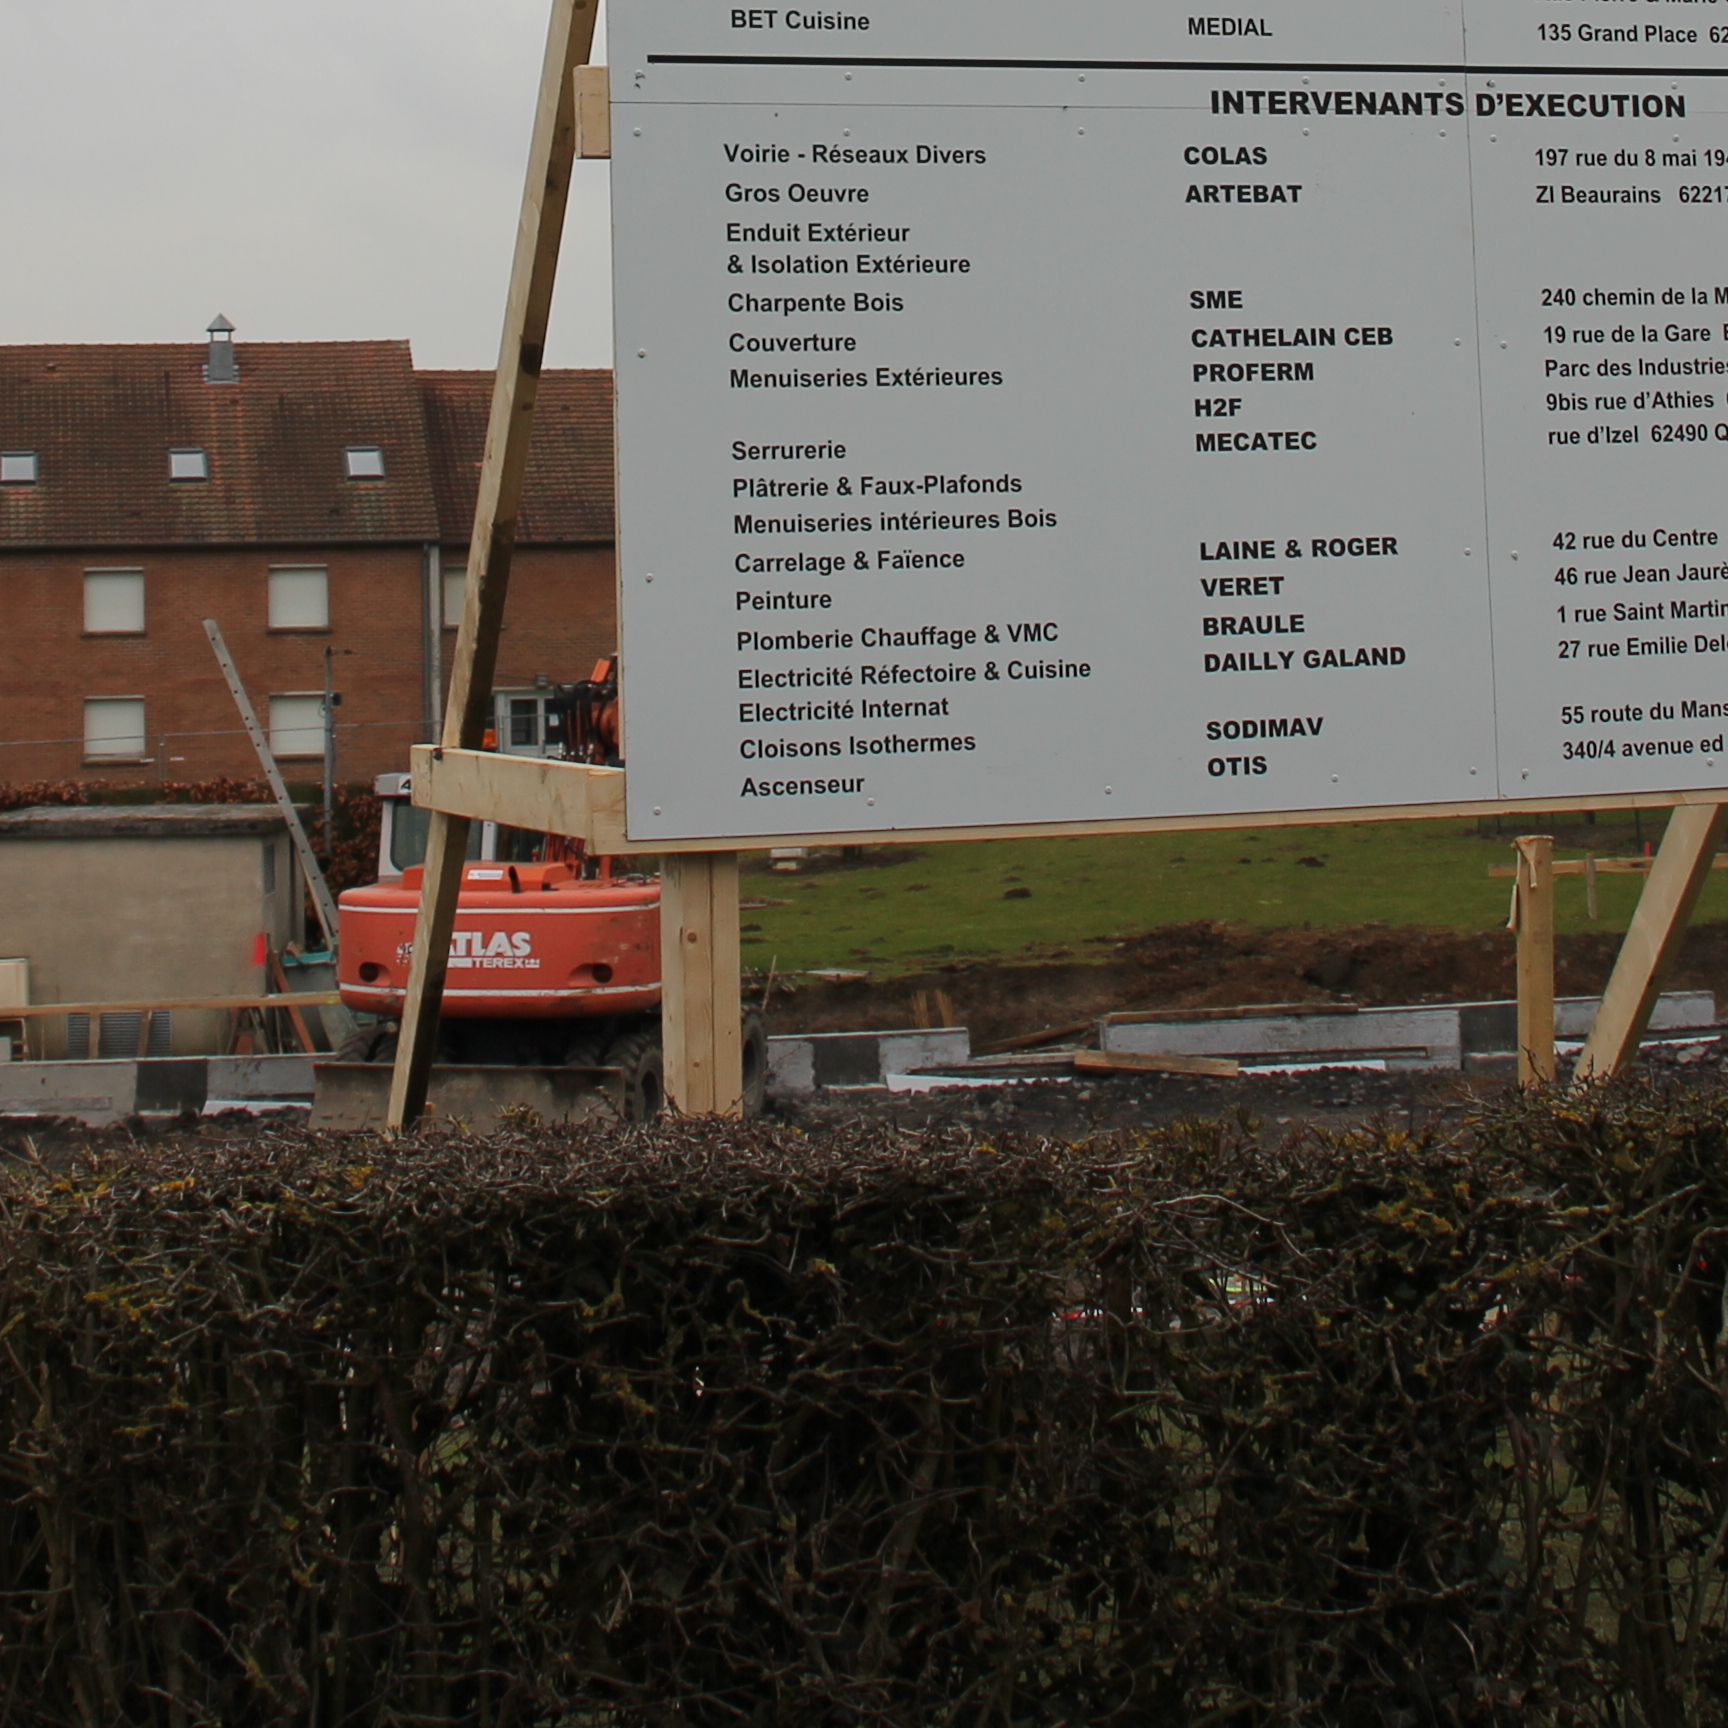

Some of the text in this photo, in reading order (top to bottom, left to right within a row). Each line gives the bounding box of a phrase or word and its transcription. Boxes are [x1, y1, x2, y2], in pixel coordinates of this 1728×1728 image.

[731, 9, 870, 31] BET Cuisine
[1188, 17, 1273, 37] MEDIAL
[1537, 23, 1572, 42] 135
[1577, 23, 1638, 43] Grand
[1644, 24, 1698, 43] Place
[1210, 90, 1686, 118] INTERVENANTS D'EXECUTION
[1183, 146, 1268, 166] COLAS
[725, 182, 869, 203] Gros Oeuvre
[1185, 184, 1303, 203] ARTEBAT
[1535, 185, 1555, 204] ZI
[1561, 185, 1662, 204] Beaurains
[726, 222, 911, 243] Enduit Extérieur
[728, 292, 904, 317] Charpente Bois
[1189, 290, 1243, 310] SME
[729, 332, 857, 353] Couverture
[1191, 327, 1394, 348] CATHELAIN CEB
[730, 366, 1003, 389] Menuiseries Extérieures
[1192, 362, 1314, 383] PROFERM
[1194, 397, 1242, 418] H2F
[731, 439, 847, 461] Serrurerie
[1195, 431, 1317, 453] MECATEC
[734, 508, 1058, 535] Menuiseries intérieures Bois
[1200, 575, 1285, 597] VERET
[736, 590, 832, 611] Peinture
[1202, 614, 1305, 637] BRAULE
[1204, 646, 1406, 673] DAILLY GALAND
[739, 697, 949, 723] Electricité Internat
[1206, 716, 1324, 741] SODIMAV
[1207, 755, 1268, 777] OTIS
[740, 777, 865, 798] Ascenseur
[449, 931, 532, 957] TLAS
[472, 957, 525, 969] TEREX
